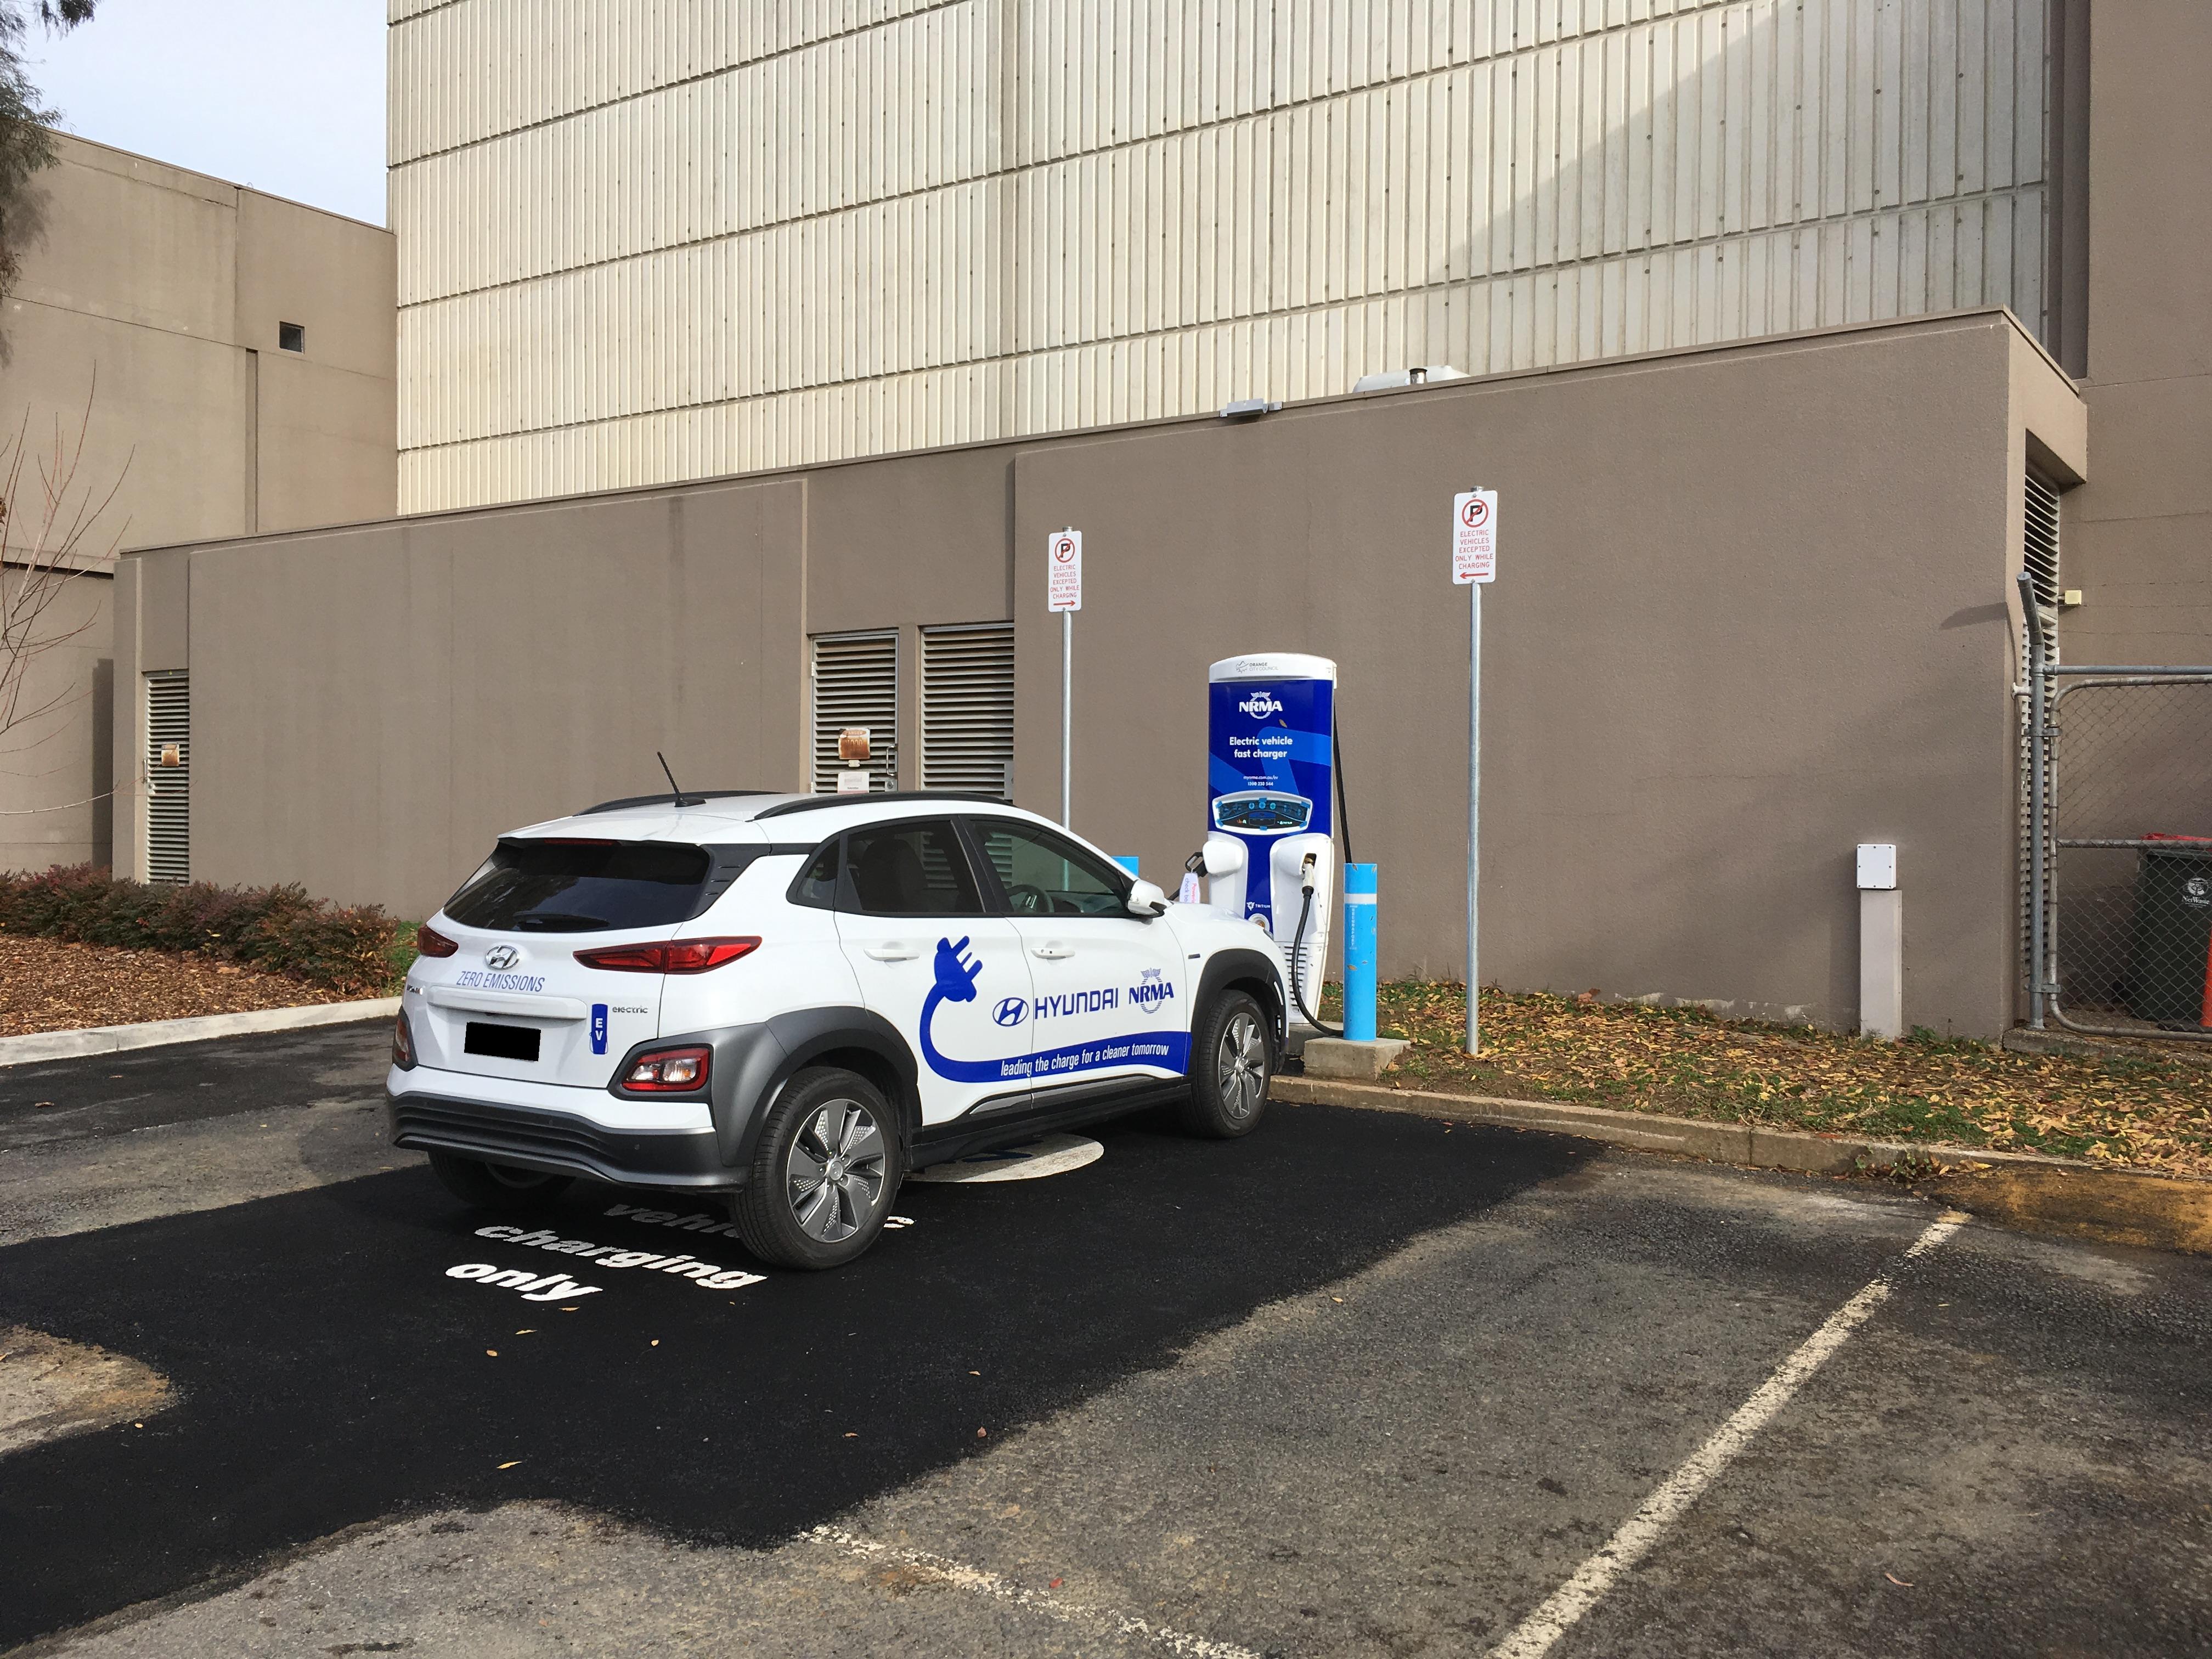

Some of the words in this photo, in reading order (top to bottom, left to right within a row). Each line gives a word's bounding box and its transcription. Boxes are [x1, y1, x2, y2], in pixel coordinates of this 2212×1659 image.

[1460, 537, 1489, 545] VEHICLES
[1239, 701, 1283, 712] NRMA
[1229, 736, 1260, 745] Electric
[1262, 736, 1293, 745] vehicle
[1234, 748, 1251, 758] fast
[1252, 748, 1288, 760] charger
[456, 971, 483, 987] ZERO
[483, 973, 545, 992] EMISSIONS
[1035, 988, 1118, 1019] HYUNDAI
[1128, 982, 1175, 1005] NRMA
[1001, 1060, 1032, 1077] leading
[1035, 1057, 1049, 1072] the
[1051, 1054, 1079, 1069] charge
[1081, 1049, 1093, 1064] for
[1095, 1051, 1100, 1062] a
[1102, 1045, 1130, 1060] cleaner
[1131, 1043, 1169, 1056] tomorrow
[474, 1226, 768, 1289] charging
[445, 1263, 603, 1301] only
